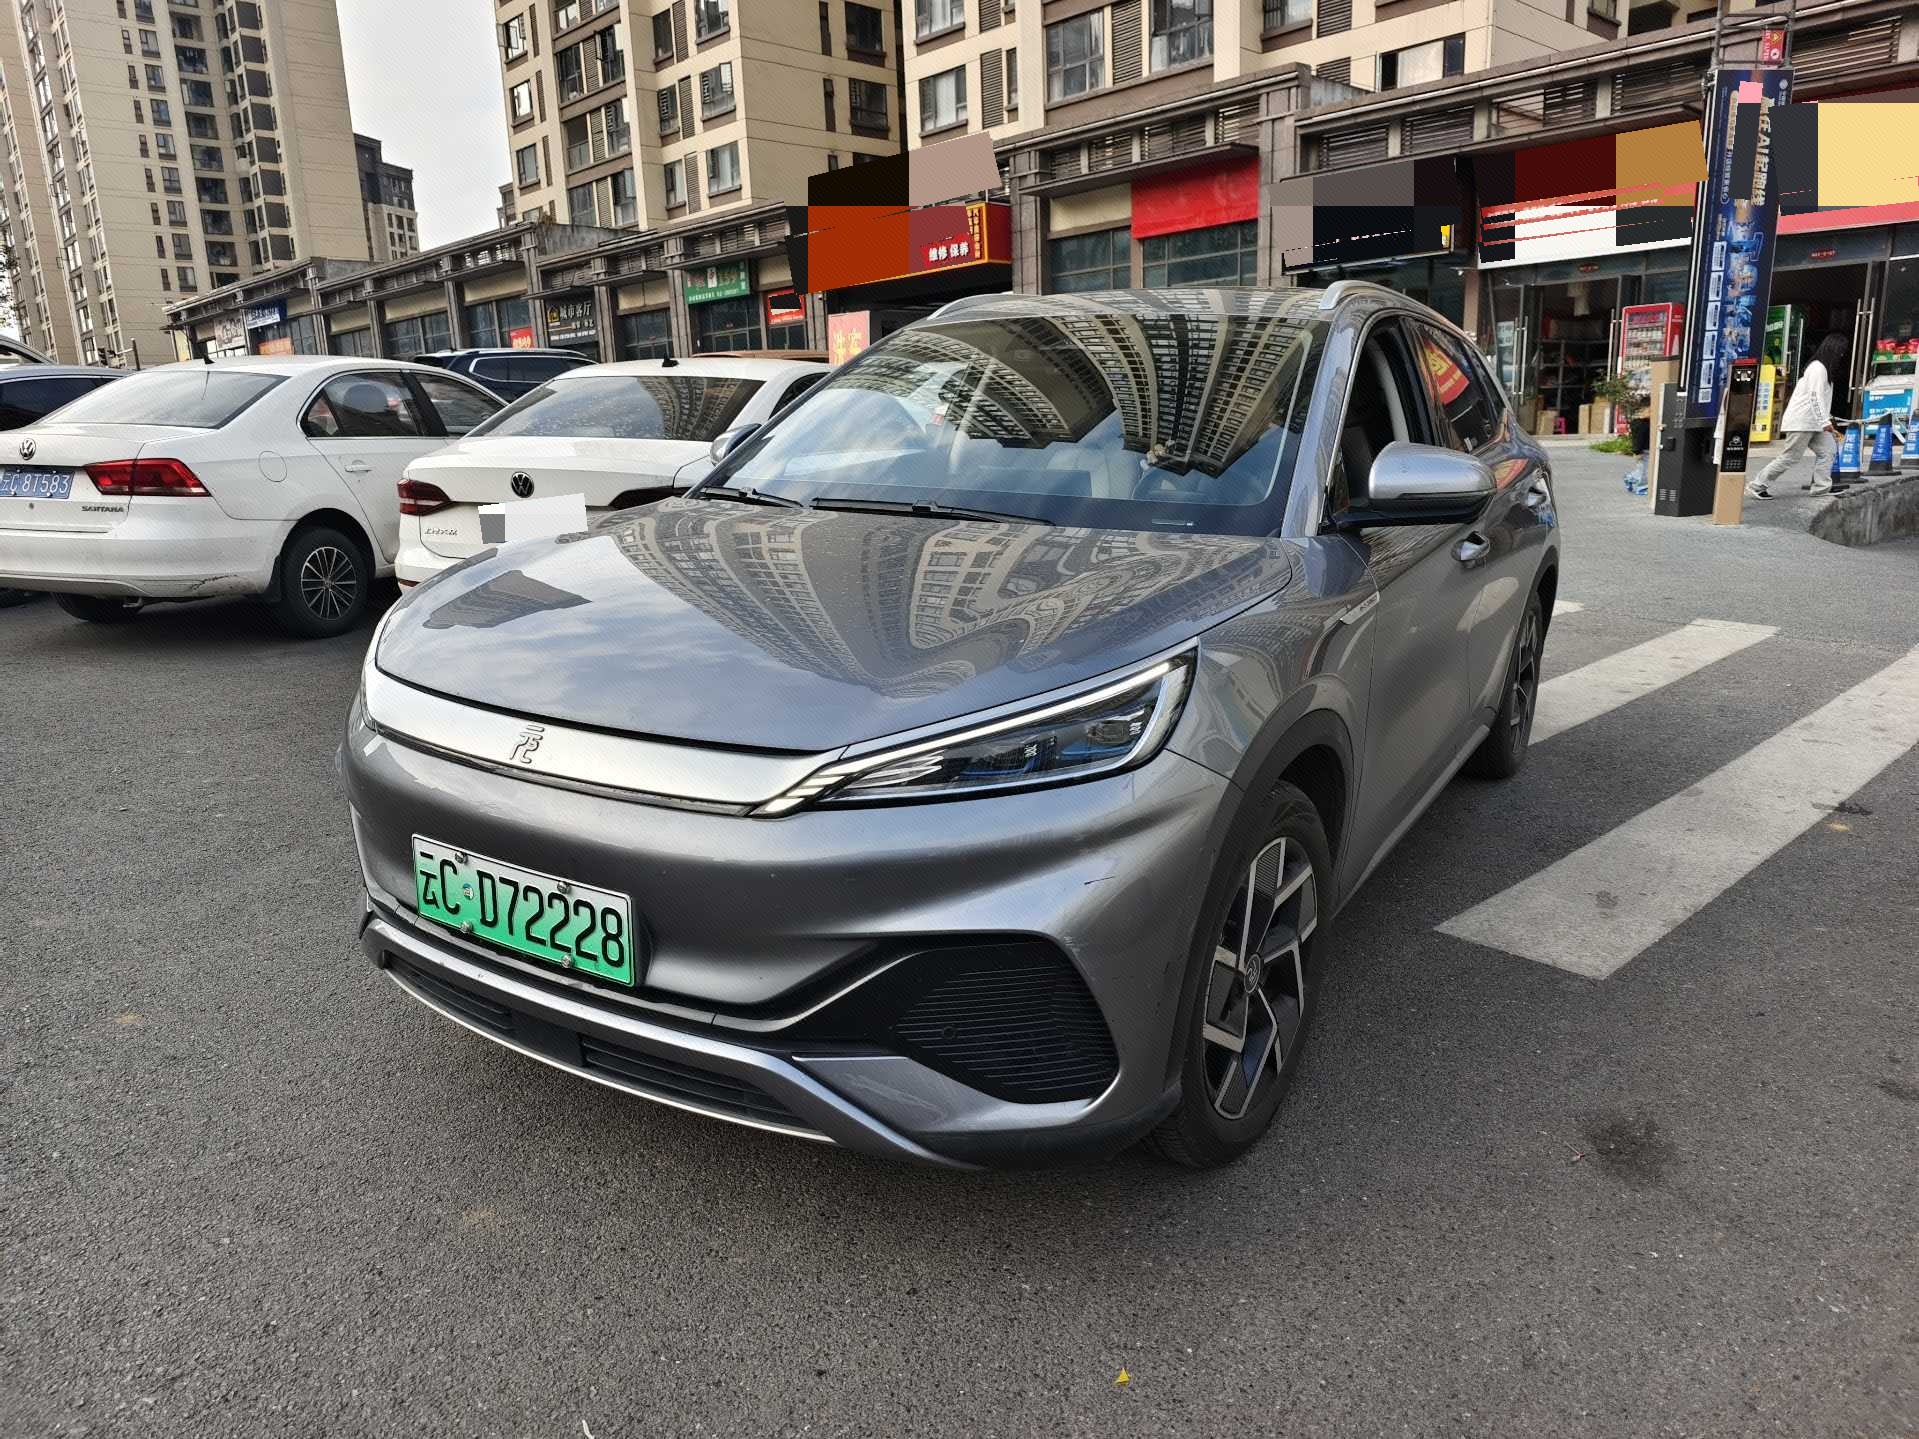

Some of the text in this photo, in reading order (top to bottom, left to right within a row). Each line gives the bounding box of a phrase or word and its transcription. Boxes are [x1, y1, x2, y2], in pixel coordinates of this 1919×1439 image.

[929, 241, 969, 262] 维修 保养
[560, 301, 592, 320] 城市客厅
[81, 505, 125, 513] SANTANA
